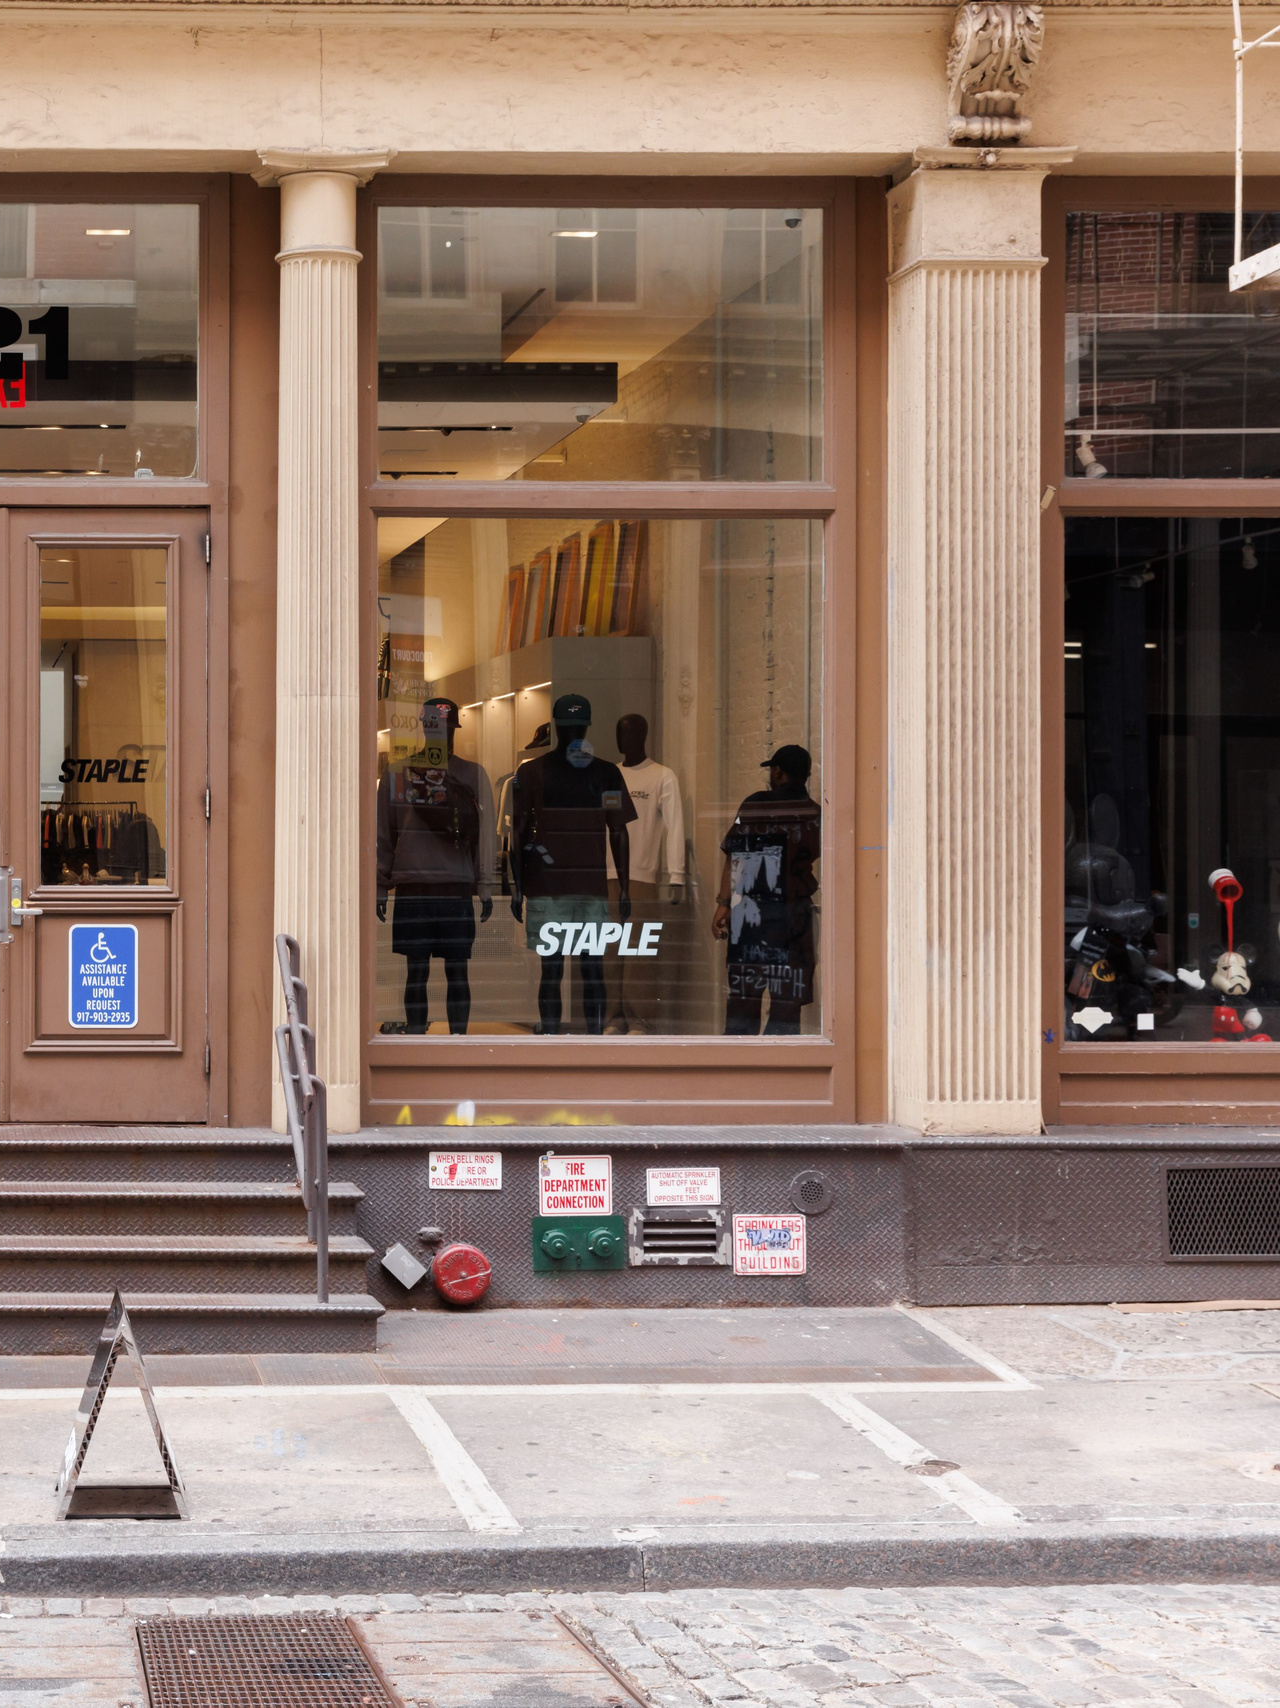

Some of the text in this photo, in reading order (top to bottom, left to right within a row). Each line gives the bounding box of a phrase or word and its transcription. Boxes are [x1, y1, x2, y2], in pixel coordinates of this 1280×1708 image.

[58, 759, 150, 783] STAPLE
[535, 921, 663, 957] STAPLE
[80, 964, 127, 974] ASSISTANCE
[82, 976, 125, 986] AVAILABLE
[92, 988, 114, 998] UPON
[86, 1000, 121, 1010] REQUEST
[76, 1012, 131, 1022] 917-903-2935
[436, 1155, 494, 1163] WHEN BELL RINGS
[477, 1167, 487, 1175] OR
[565, 1163, 585, 1175] FIRE
[432, 1177, 498, 1186] POLICE DEPARTMENT
[544, 1179, 607, 1192] DEPARTMENT
[546, 1195, 605, 1209] CONNECTION
[741, 1256, 800, 1269] BUILDING
